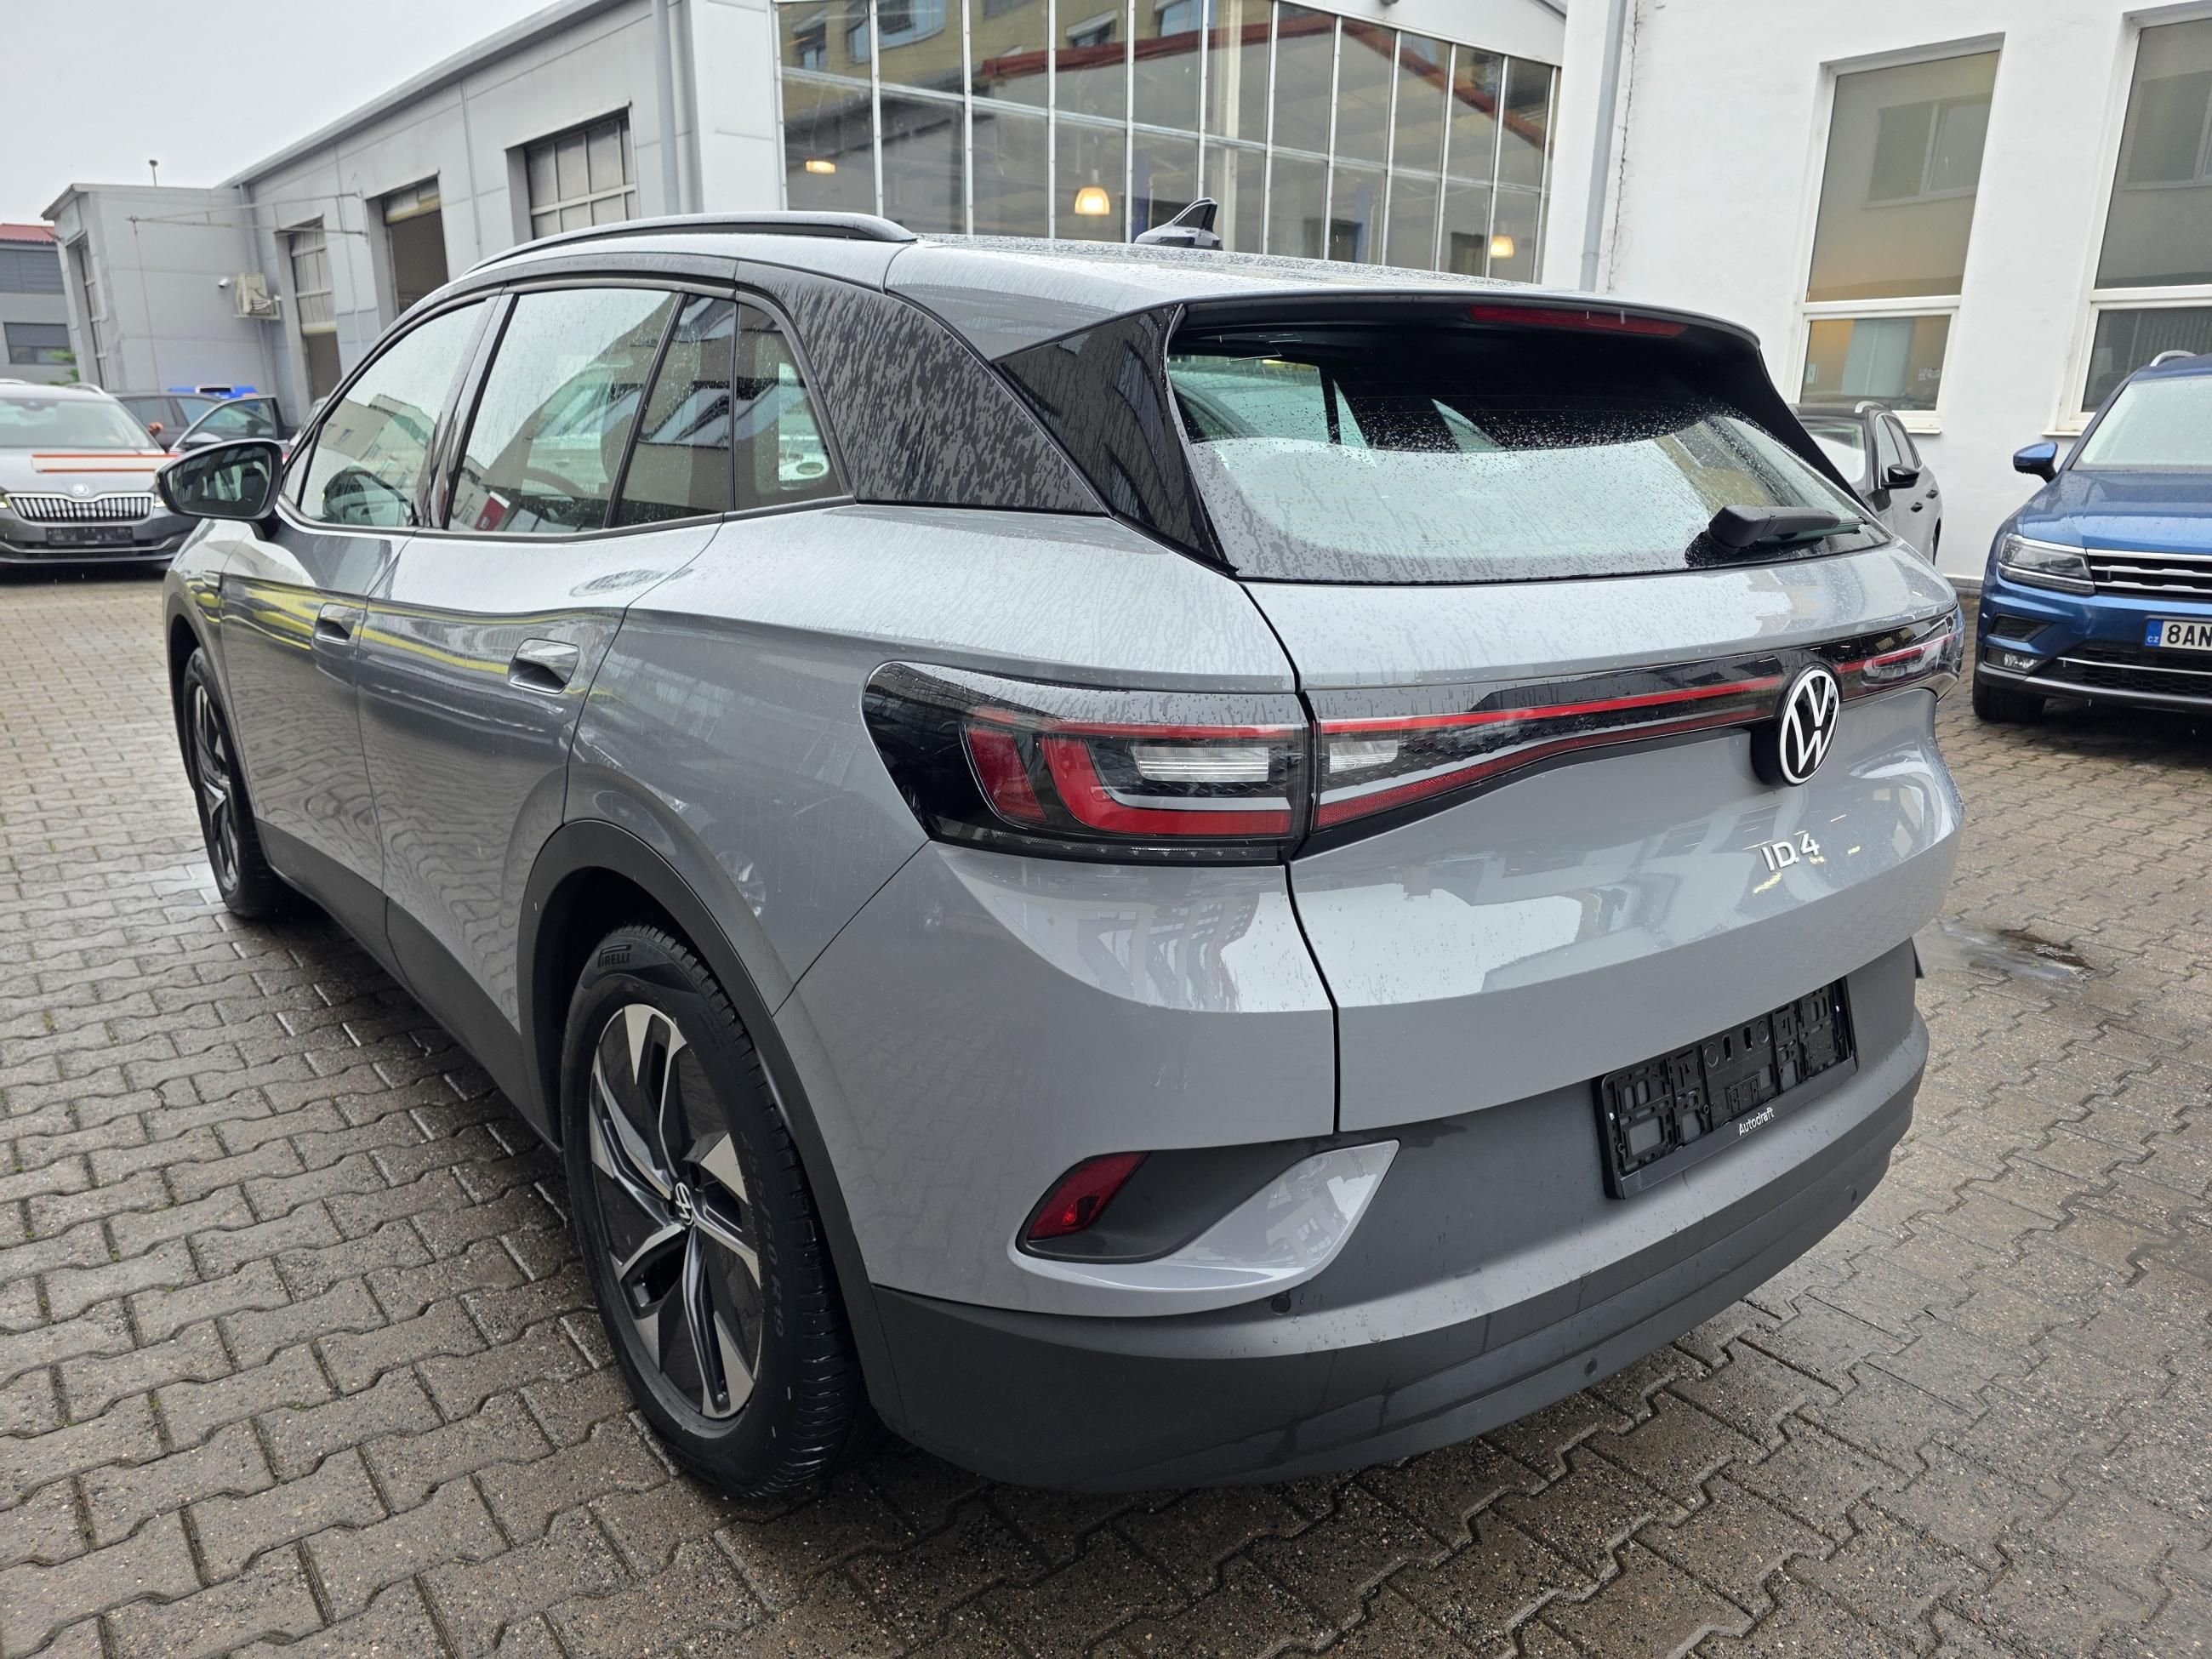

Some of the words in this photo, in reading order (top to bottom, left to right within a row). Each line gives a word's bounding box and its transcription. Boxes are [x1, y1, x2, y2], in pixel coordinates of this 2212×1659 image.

[2167, 624, 2212, 647] 8AN
[598, 944, 632, 967] PIRELLI
[1739, 1107, 1775, 1137] Autodraft
